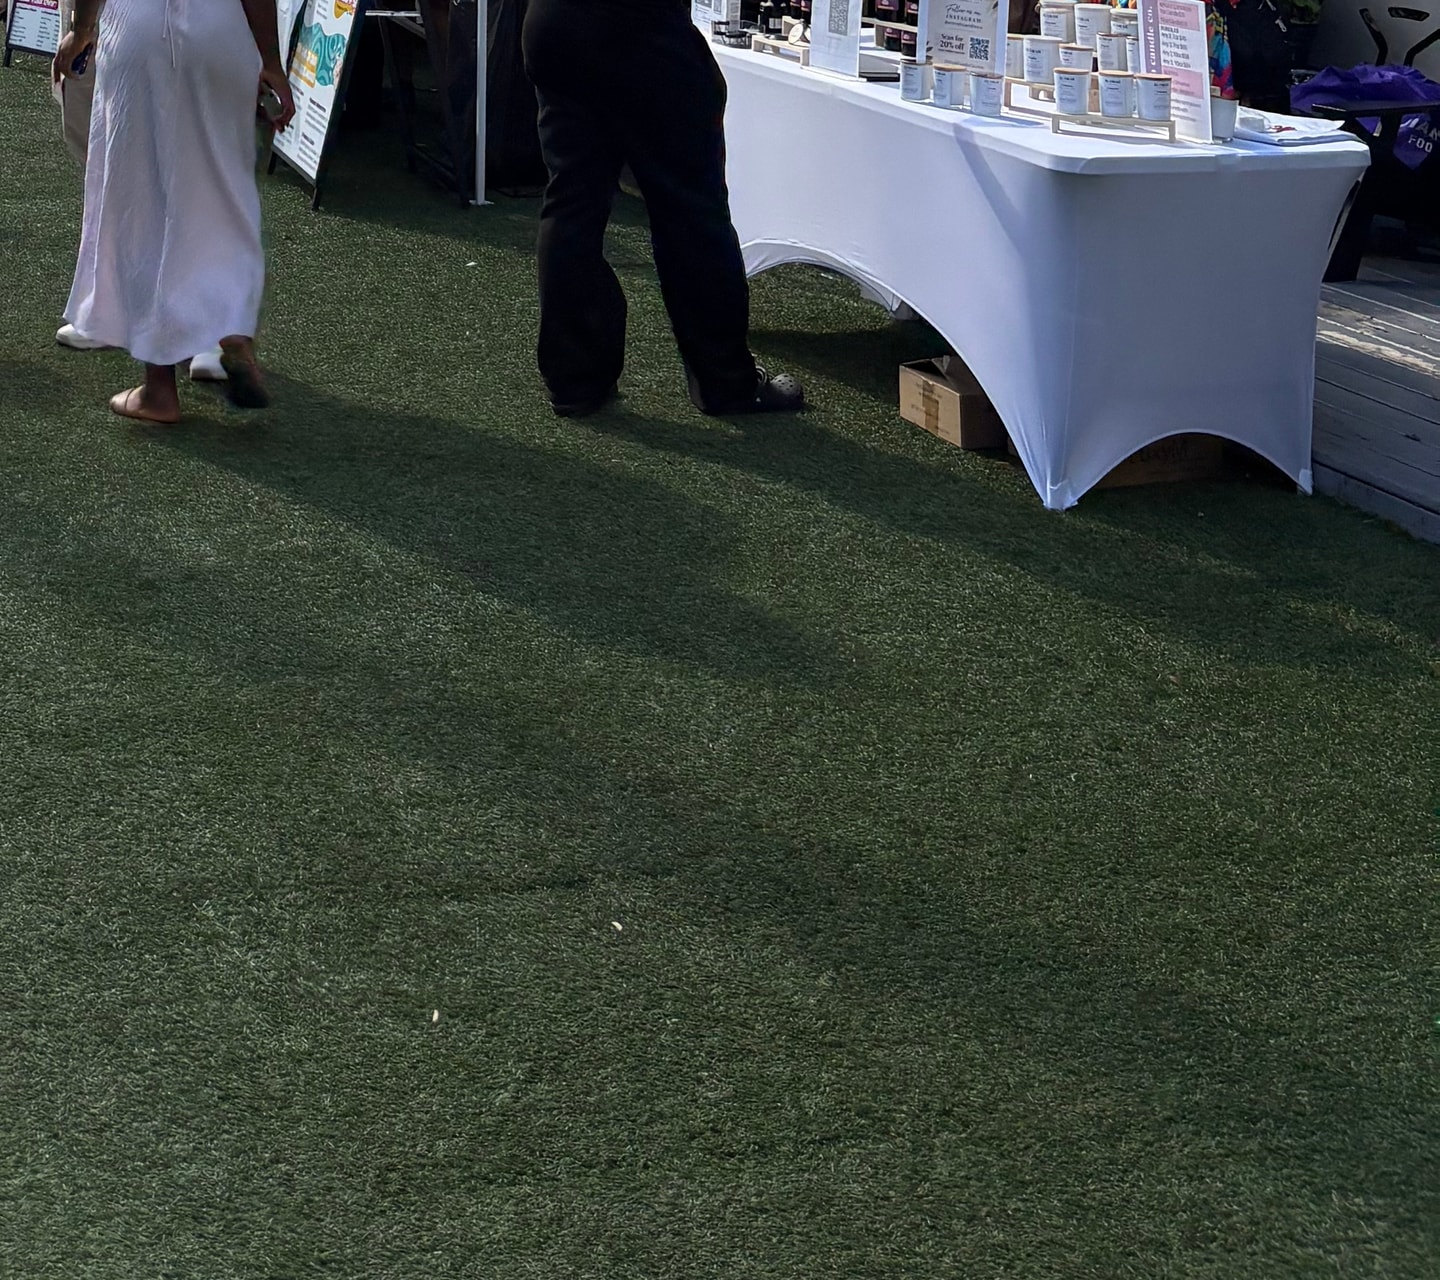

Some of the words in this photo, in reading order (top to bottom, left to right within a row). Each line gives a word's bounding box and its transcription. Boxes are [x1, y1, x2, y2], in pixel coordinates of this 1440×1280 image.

[945, 14, 982, 23] INSTAGRAM
[955, 34, 964, 42] for
[940, 40, 954, 49] 20%
[955, 42, 965, 51] off
[1146, 26, 1156, 66] candle
